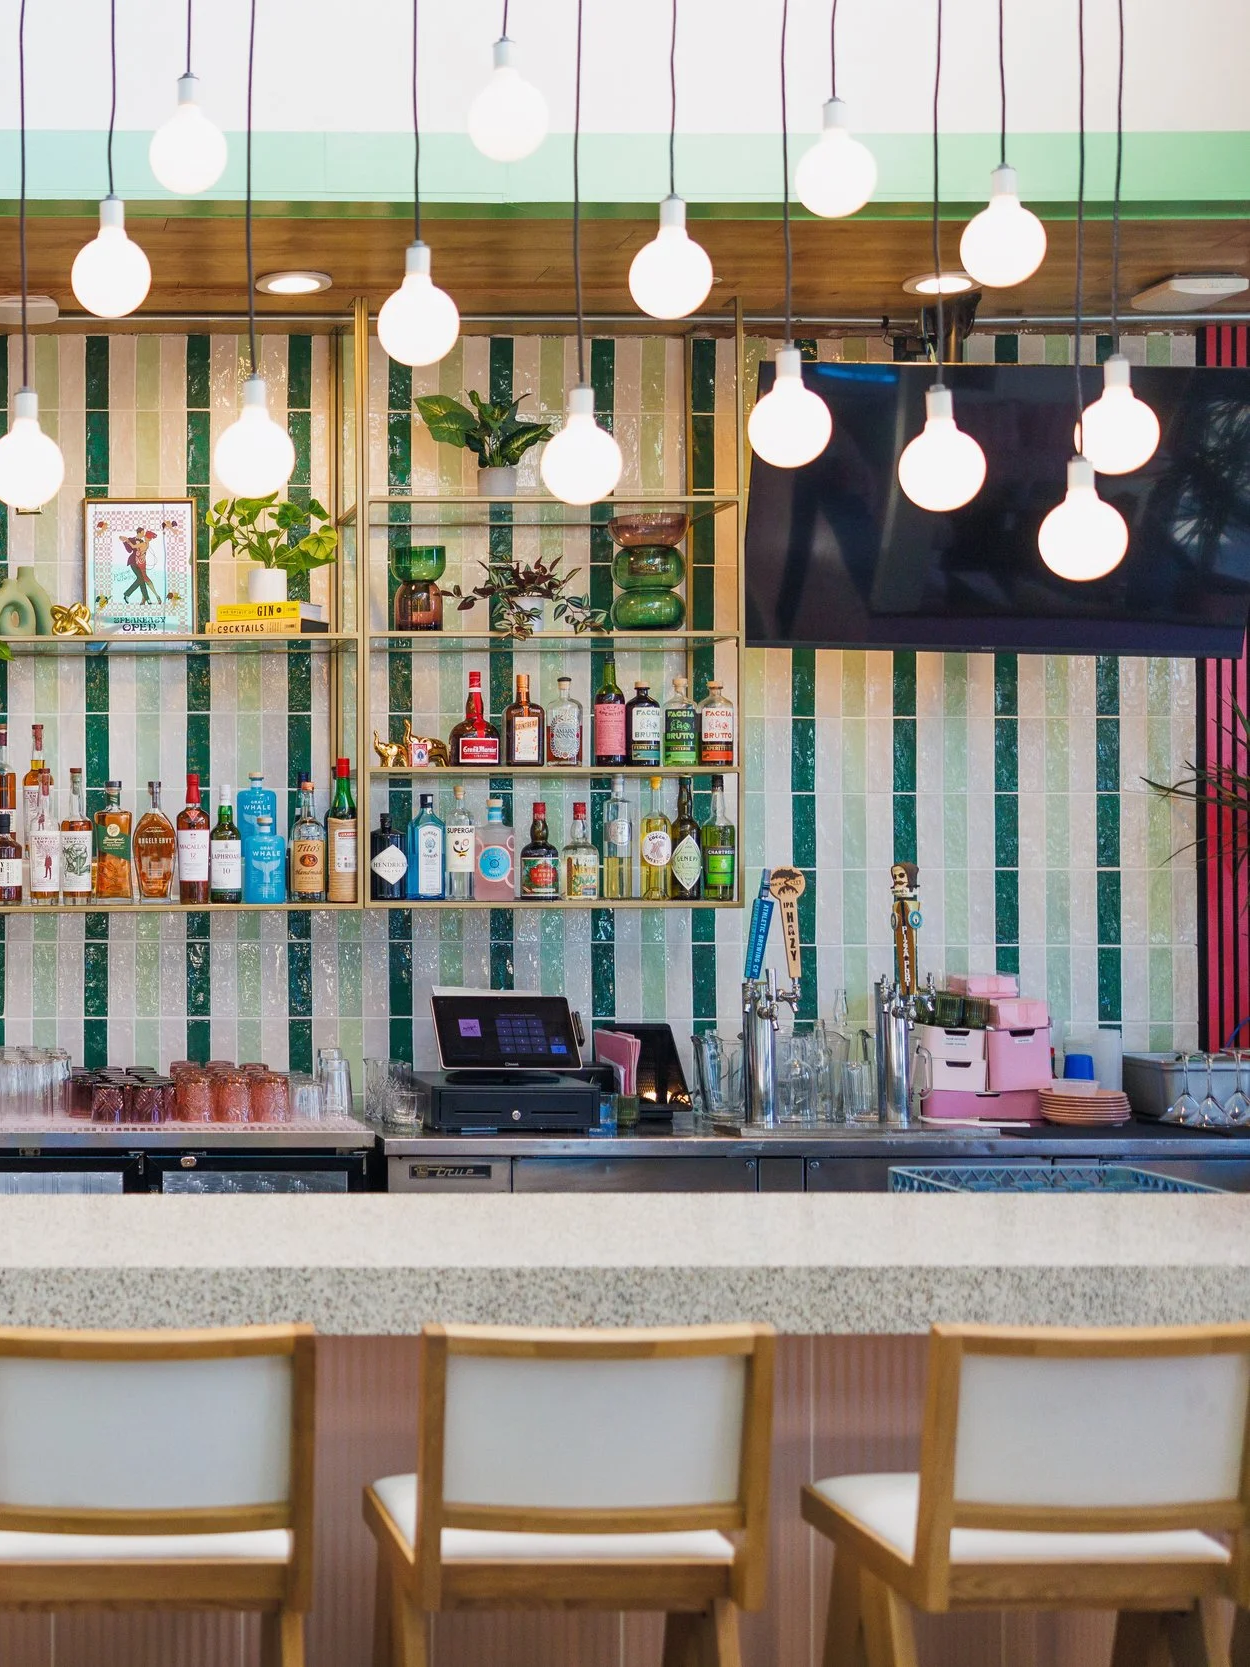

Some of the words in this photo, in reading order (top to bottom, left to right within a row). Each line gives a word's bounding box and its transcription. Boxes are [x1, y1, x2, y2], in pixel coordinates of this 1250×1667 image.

[257, 605, 274, 617] GIN
[113, 616, 166, 624] SPEAKEASY
[122, 623, 158, 632] OPEN
[217, 623, 264, 634] COCKTAILS
[667, 710, 695, 718] FACCIA
[667, 732, 695, 740] BRUTTO
[297, 843, 320, 853] Tito's
[783, 901, 794, 909] IPA
[759, 903, 770, 933] ATHLETIC
[786, 911, 798, 961] HAZY
[901, 926, 910, 958] PIZZA
[753, 934, 765, 965] BREWING
[903, 960, 911, 987] PORT
[436, 1167, 474, 1177] true
